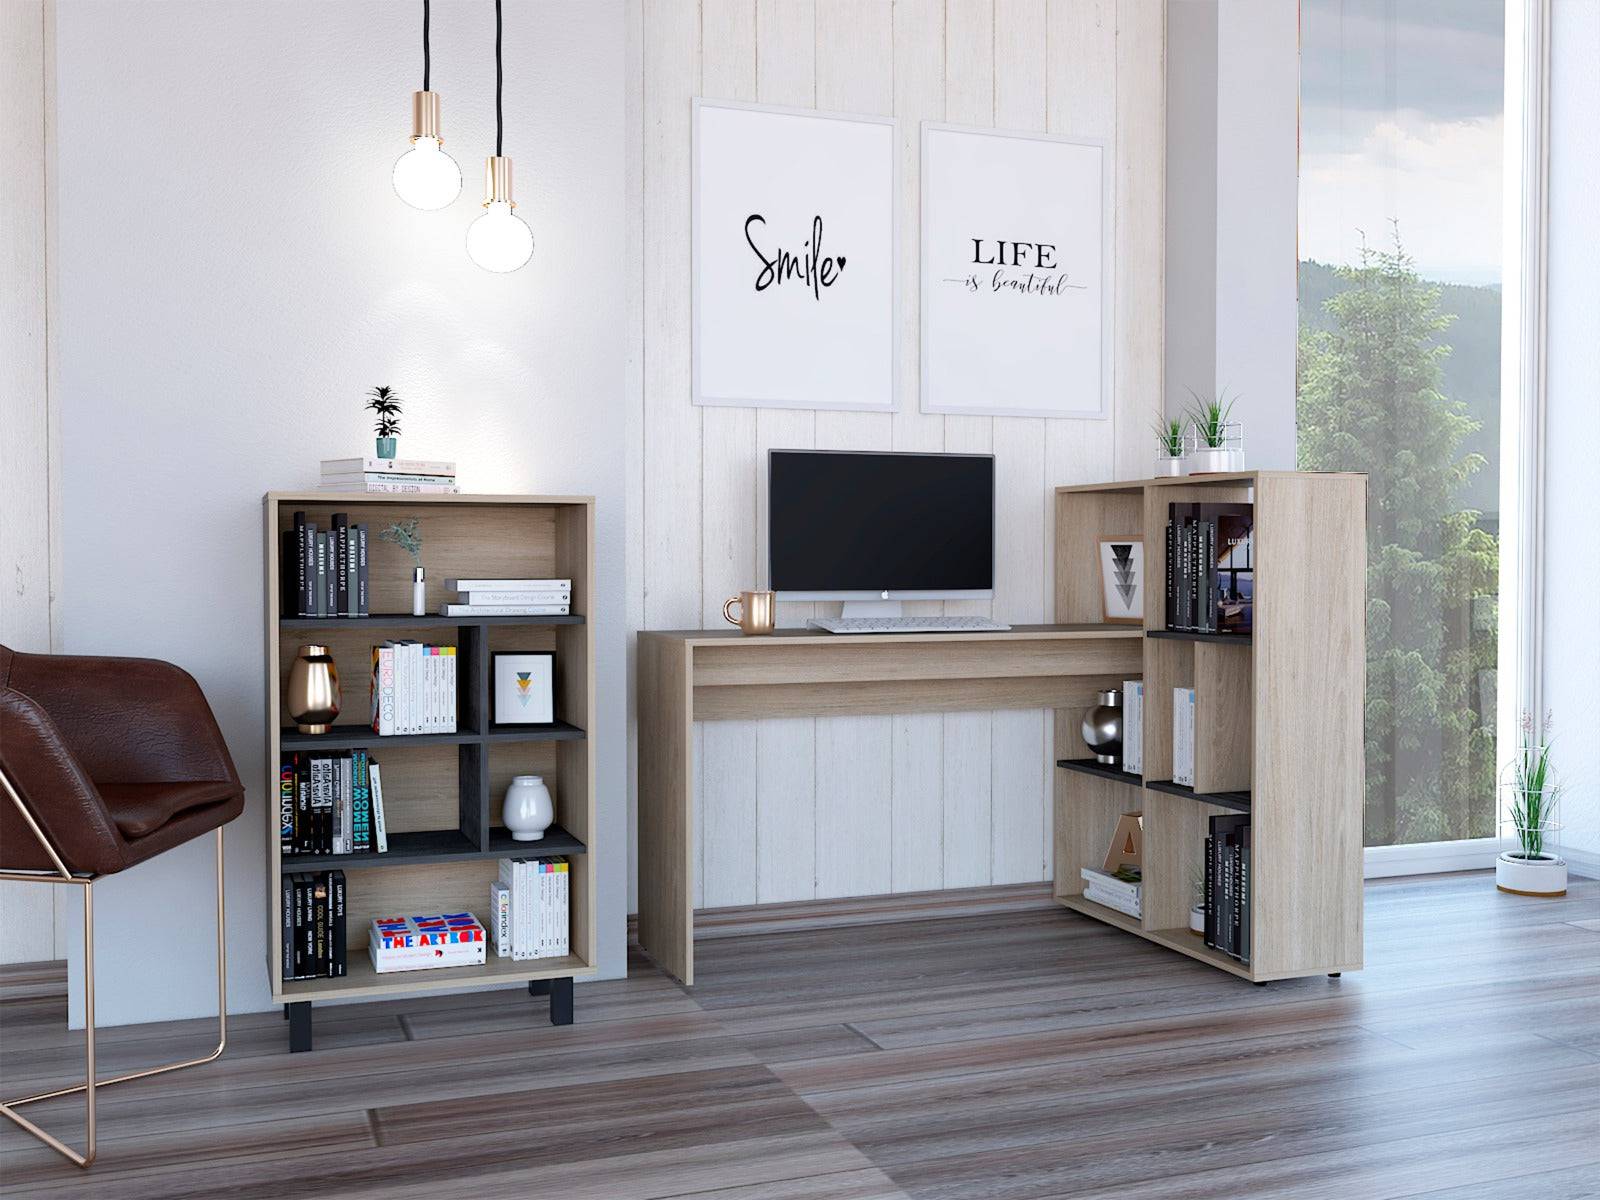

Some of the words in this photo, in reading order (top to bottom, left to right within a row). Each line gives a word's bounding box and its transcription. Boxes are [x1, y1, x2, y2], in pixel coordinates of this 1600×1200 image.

[744, 213, 839, 301] Smile
[971, 238, 1058, 269] LIFE
[956, 273, 983, 292] is
[992, 269, 1078, 296] beautiful
[382, 936, 414, 949] THE
[420, 932, 448, 946] ART
[450, 929, 483, 944] BOOK
